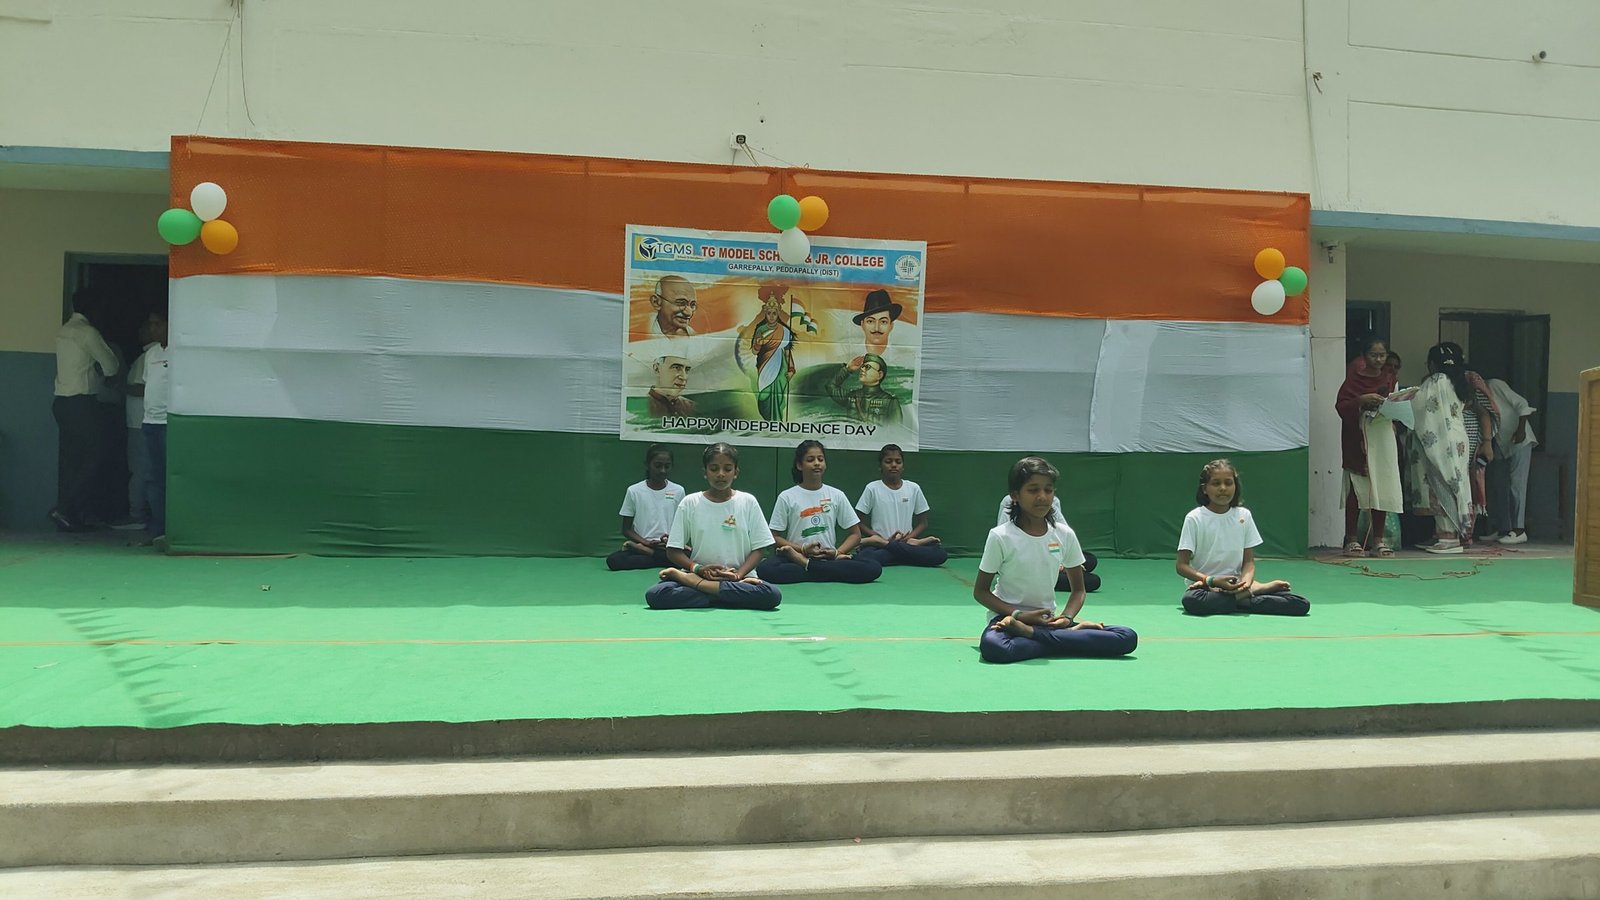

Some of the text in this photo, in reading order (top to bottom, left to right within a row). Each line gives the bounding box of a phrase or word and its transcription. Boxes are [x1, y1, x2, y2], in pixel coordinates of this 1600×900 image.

[657, 243, 692, 255] TGMS
[702, 246, 715, 257] TG
[719, 247, 756, 260] MODEL
[804, 254, 812, 264] &
[815, 254, 831, 265] JR.
[835, 254, 884, 267] COLLEGE
[728, 263, 839, 278] GARREPALLY, PEDDAPALLY (DIST)
[662, 416, 876, 436] HAPPY INDEPENDENCE DAY
